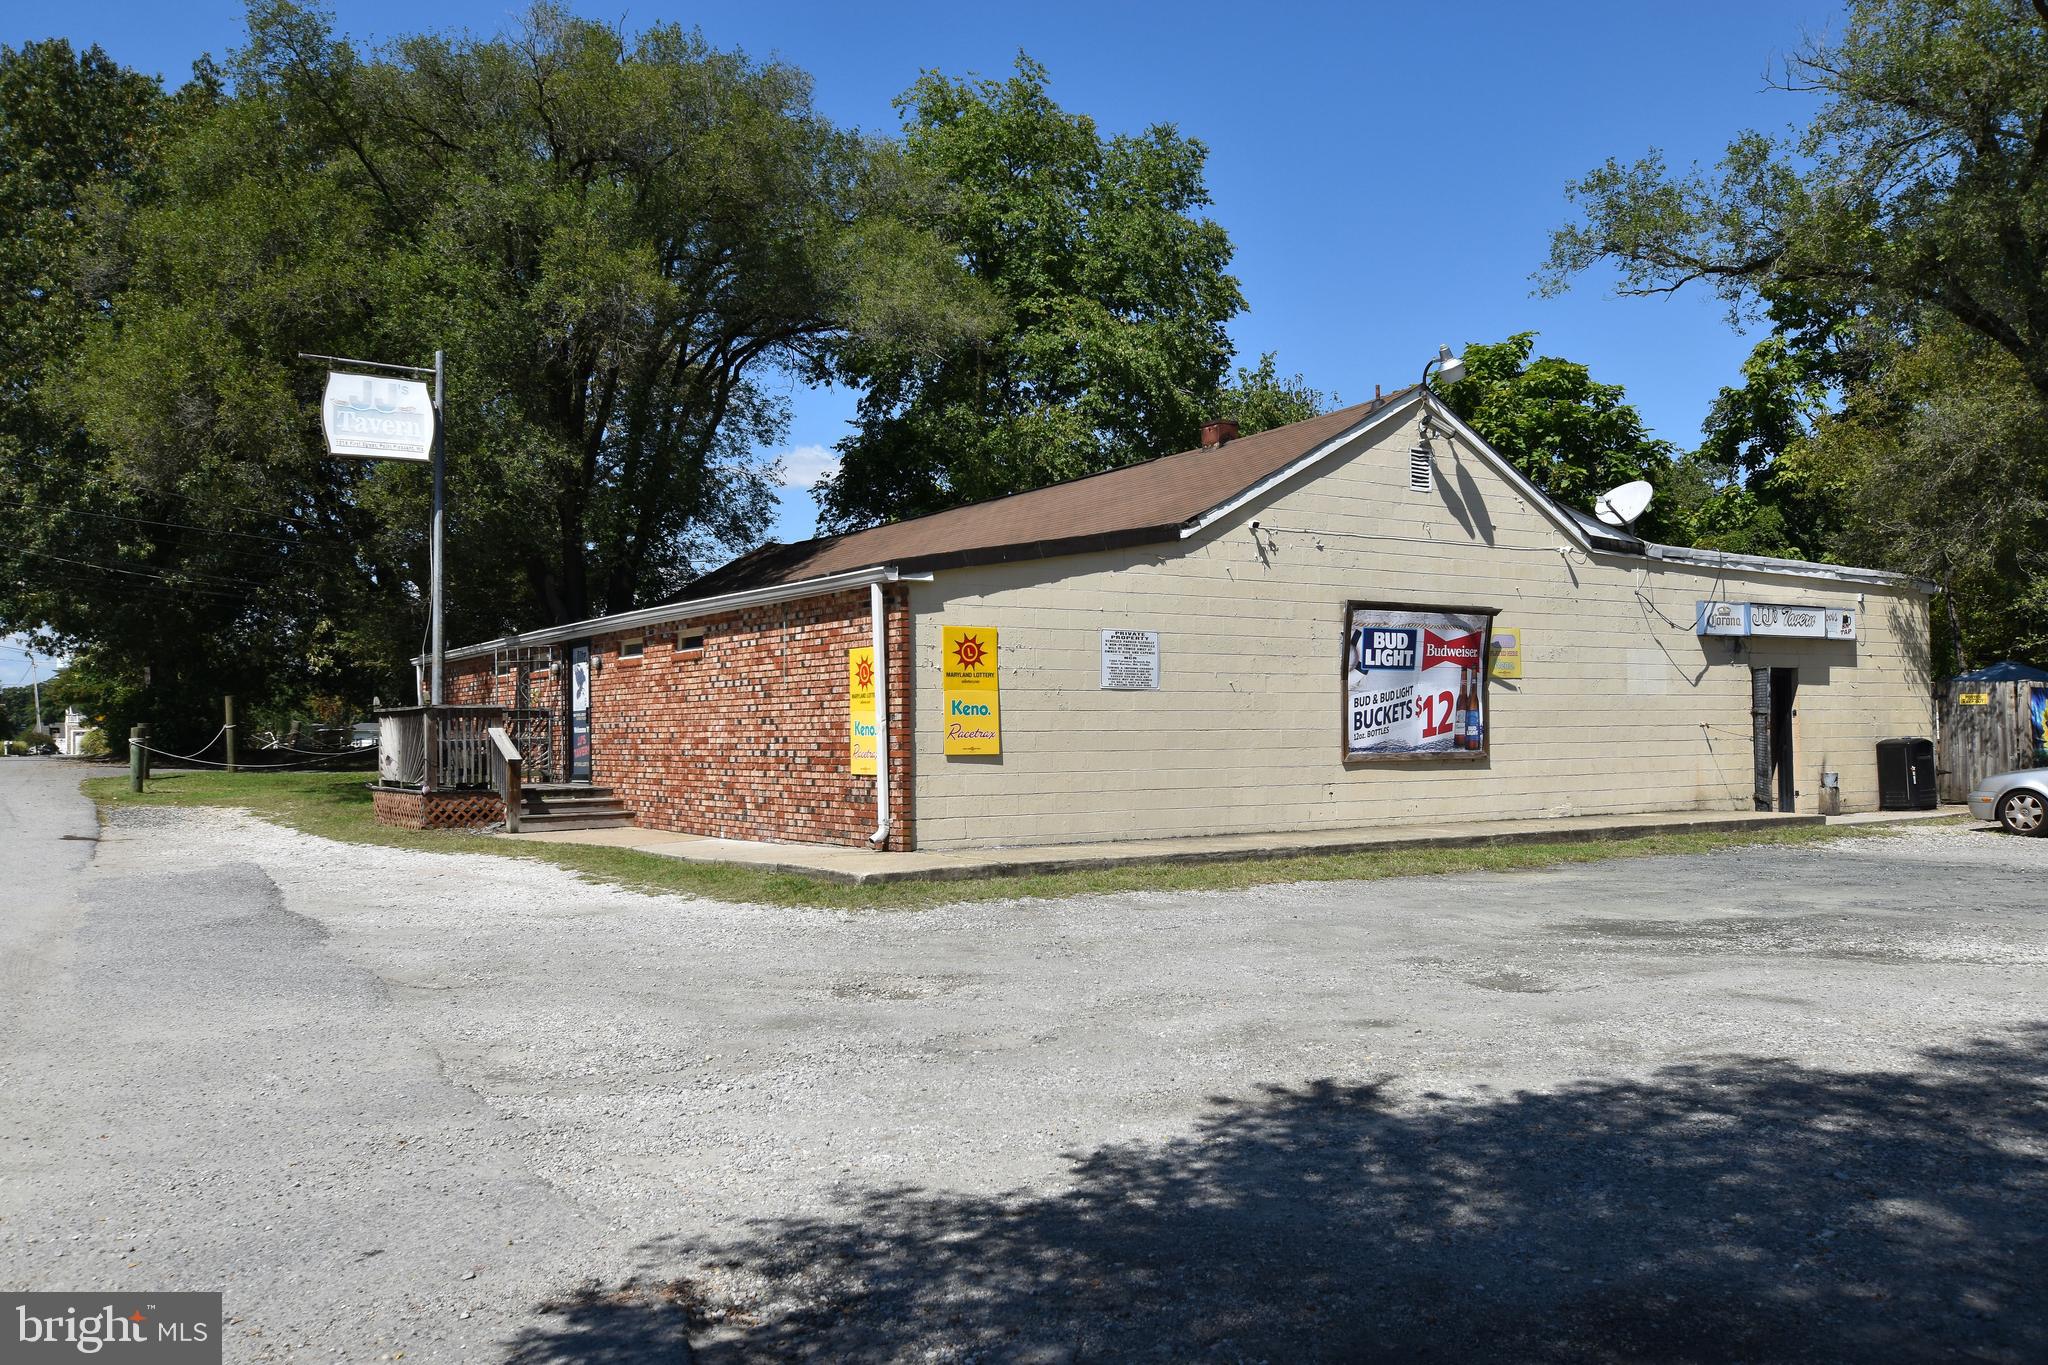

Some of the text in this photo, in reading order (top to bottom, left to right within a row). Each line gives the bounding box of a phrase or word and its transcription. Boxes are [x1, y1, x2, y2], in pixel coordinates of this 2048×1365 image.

[336, 410, 422, 438] Tavern
[1709, 614, 1741, 628] Corona
[1782, 607, 1816, 628] Tavern
[1373, 632, 1409, 649] BUD
[1353, 685, 1414, 708] BUD & BUD LIGHT
[1353, 690, 1454, 738] BUCKETS $12
[947, 723, 997, 740] Racetrax
[1366, 726, 1390, 738] BOTTLES
